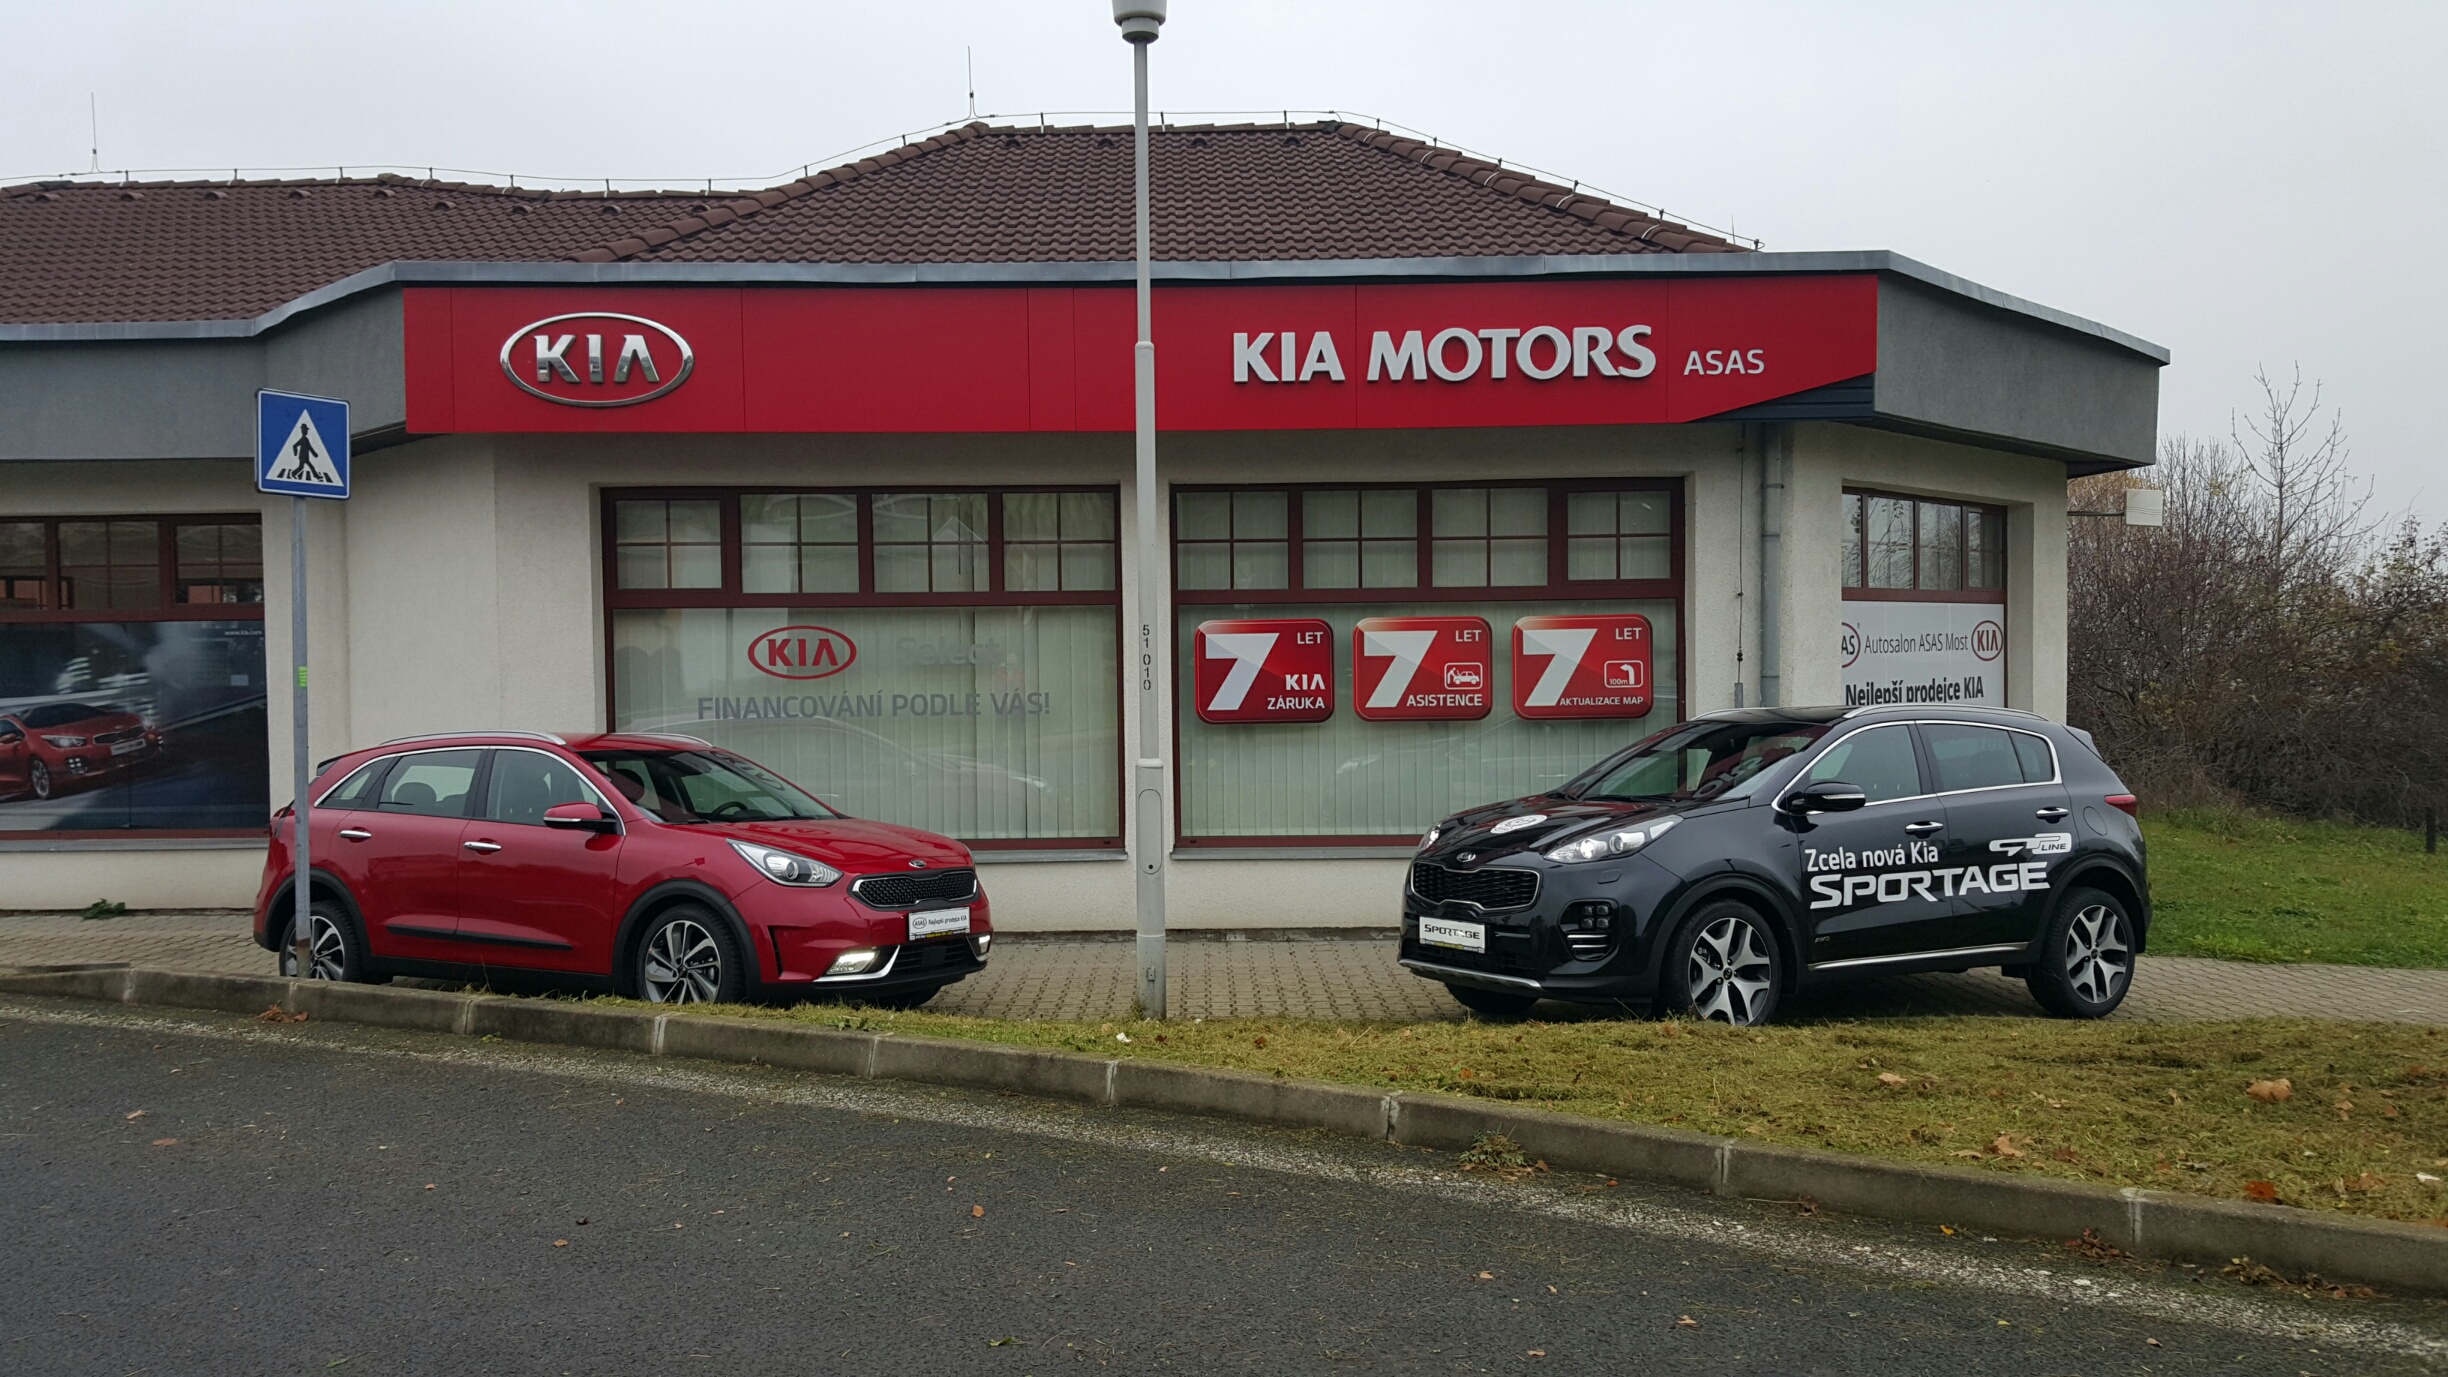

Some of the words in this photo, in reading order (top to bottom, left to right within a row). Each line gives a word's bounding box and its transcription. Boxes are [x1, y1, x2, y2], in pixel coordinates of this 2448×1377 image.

[534, 334, 660, 383] KIA
[1233, 331, 1346, 383] KIA
[1366, 324, 1657, 382] MOTORS
[1683, 349, 1765, 376] ASAS
[766, 638, 839, 667] KIA
[1864, 633, 1916, 654] Autosalon
[1919, 633, 1943, 653] ASAS
[1945, 633, 1968, 651] Most
[1976, 629, 1999, 652] KIA
[1206, 633, 1280, 710] 7
[1297, 631, 1323, 644] LET
[1364, 630, 1438, 707] 7
[1455, 630, 1482, 642] LET
[1523, 628, 1598, 706] 7
[1615, 628, 1642, 640] LET
[1285, 673, 1326, 691] KIA
[1964, 676, 1984, 699] KIA
[698, 689, 883, 720] FINANCOVÁNÍ
[892, 693, 981, 717] PODLE
[990, 688, 1050, 715] VÁS!
[1267, 695, 1325, 710] ZÁRUKA
[1406, 694, 1483, 707] ASISTENCE
[1560, 697, 1620, 706] AKTUALIZACE
[1623, 696, 1643, 705] MAP
[1804, 847, 1856, 872] Zcela
[1862, 843, 1906, 868] nová
[1910, 841, 1939, 864] Kia
[2041, 843, 2067, 851] LINE
[1809, 861, 2051, 910] SPORTAGE
